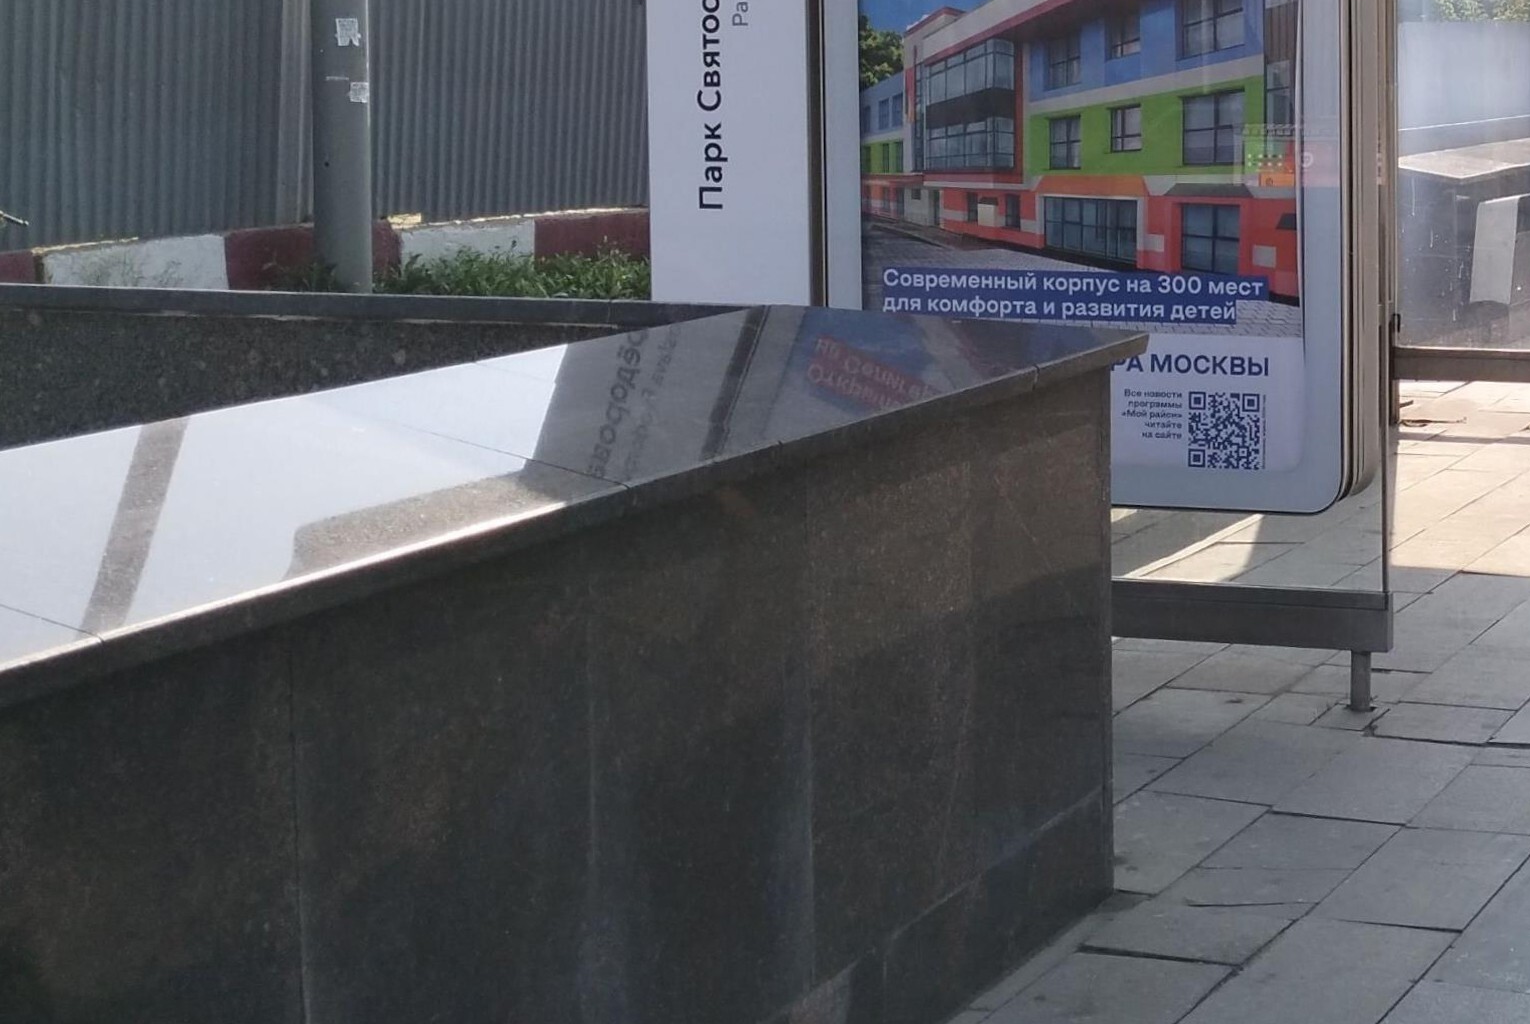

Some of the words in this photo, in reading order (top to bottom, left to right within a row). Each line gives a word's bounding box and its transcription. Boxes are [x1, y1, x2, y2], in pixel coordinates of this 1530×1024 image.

[699, 122, 728, 209] Парк
[883, 268, 1037, 291] Современный
[1043, 278, 1120, 296] корпус
[1126, 279, 1151, 293] на
[1157, 276, 1201, 294] 300
[1208, 281, 1264, 295] мест
[882, 297, 922, 313] для
[927, 295, 1038, 317] комфорта
[1043, 301, 1056, 315] и
[1062, 301, 1165, 320] развития
[1170, 301, 1236, 321] детей
[1150, 353, 1269, 376] МОСКВЫ
[1124, 388, 1142, 398] Все
[1144, 391, 1182, 399] новости
[1128, 401, 1182, 409] программы
[1144, 420, 1182, 429] читайте
